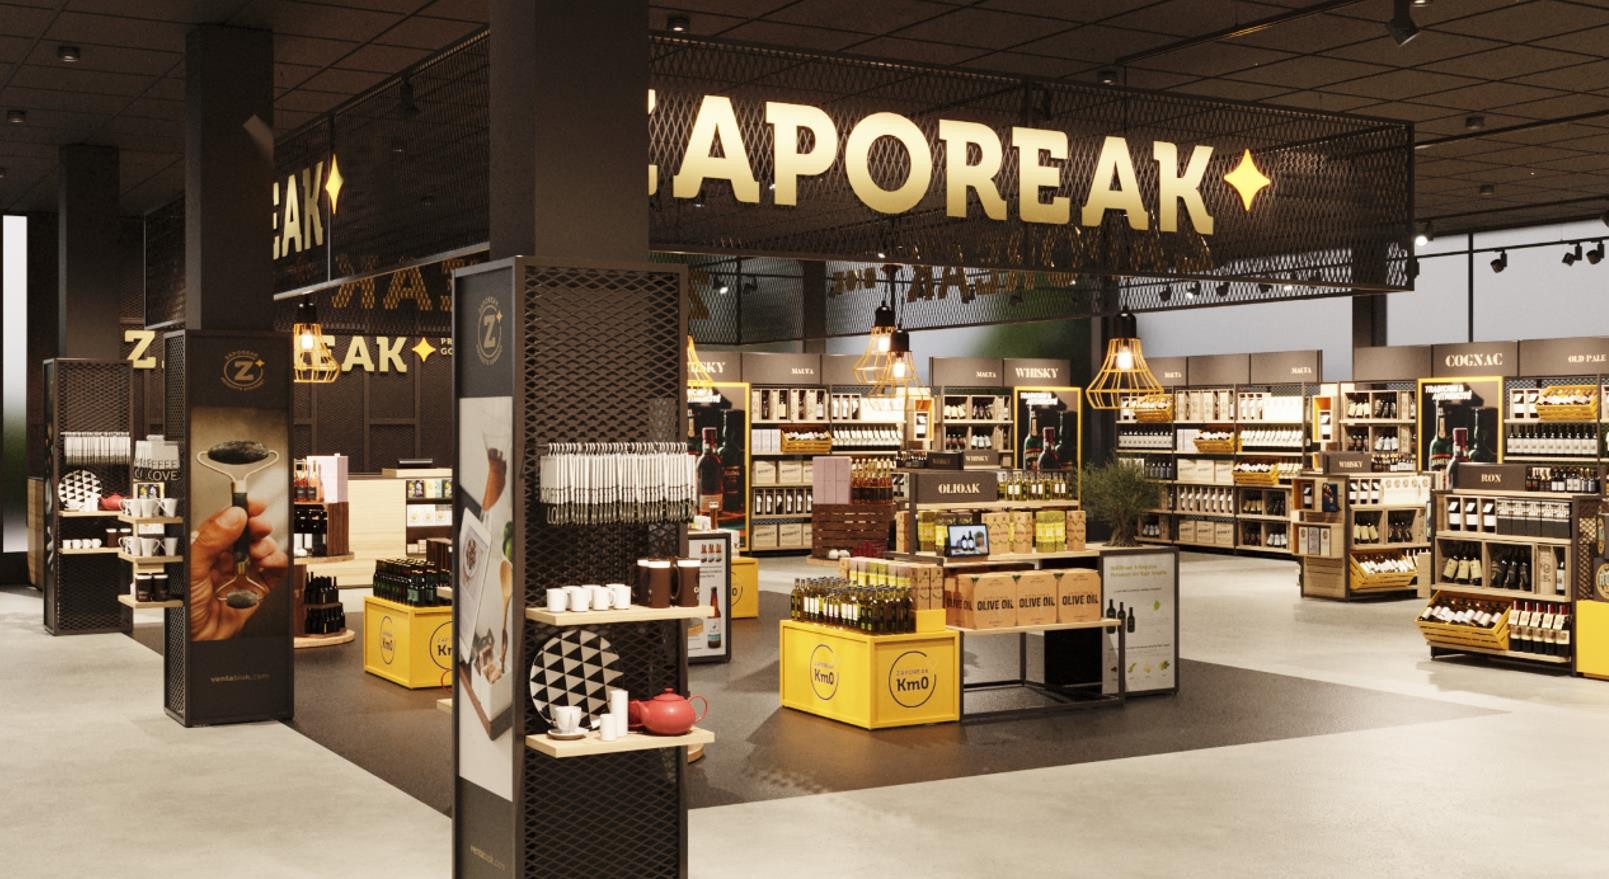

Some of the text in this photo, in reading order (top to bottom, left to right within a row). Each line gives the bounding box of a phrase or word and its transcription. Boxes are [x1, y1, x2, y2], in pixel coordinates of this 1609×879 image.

[648, 89, 1214, 235] APOREAK
[1445, 353, 1503, 367] COGNAC
[1567, 354, 1607, 363] OLD PALE
[234, 361, 255, 381] Z
[1015, 367, 1059, 378] WHISKY
[1338, 460, 1363, 468] WHISKY
[937, 483, 980, 494] OLIOAK
[977, 599, 1014, 611] OLIVE OIL
[1019, 596, 1056, 608] OLIVE OIL
[1062, 594, 1099, 605] OLIVE OIL
[814, 668, 835, 685] Km0
[896, 676, 929, 692] Km0
